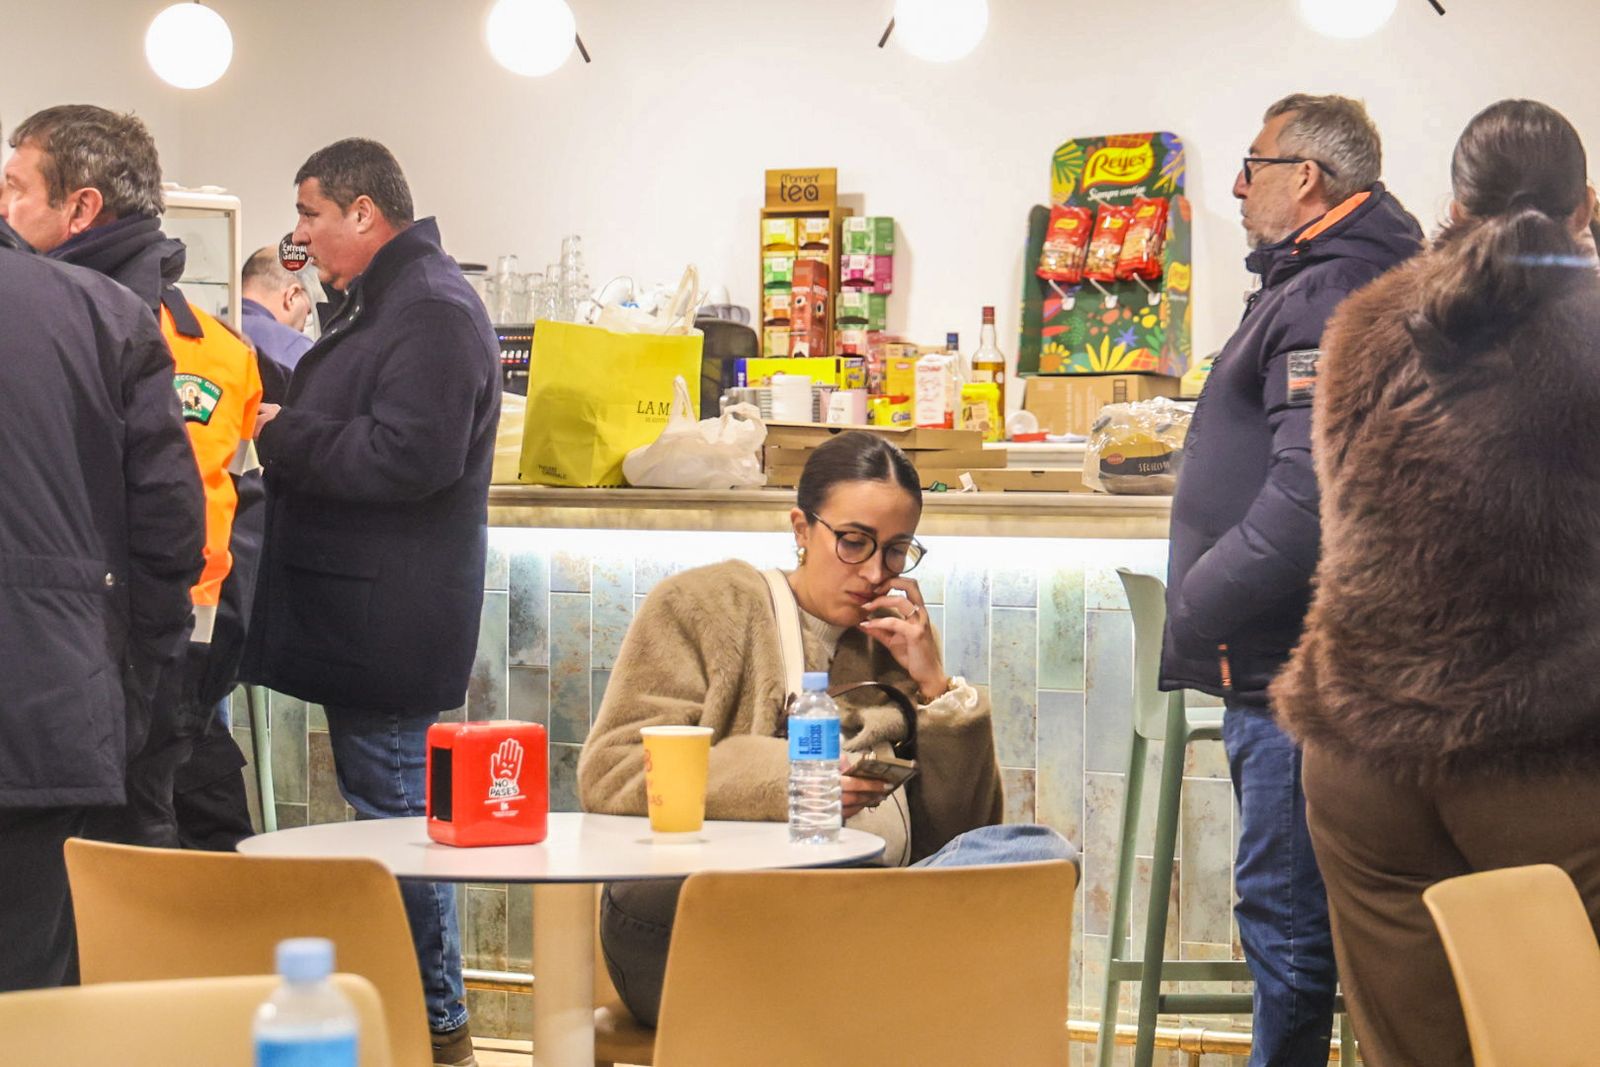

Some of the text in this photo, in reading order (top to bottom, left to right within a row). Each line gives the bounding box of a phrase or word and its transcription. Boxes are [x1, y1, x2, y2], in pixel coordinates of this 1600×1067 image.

[1091, 152, 1146, 178] Reyes
[780, 182, 819, 203] tea
[637, 400, 655, 415] LA
[490, 785, 518, 797] PASES
[495, 779, 509, 788] NO
